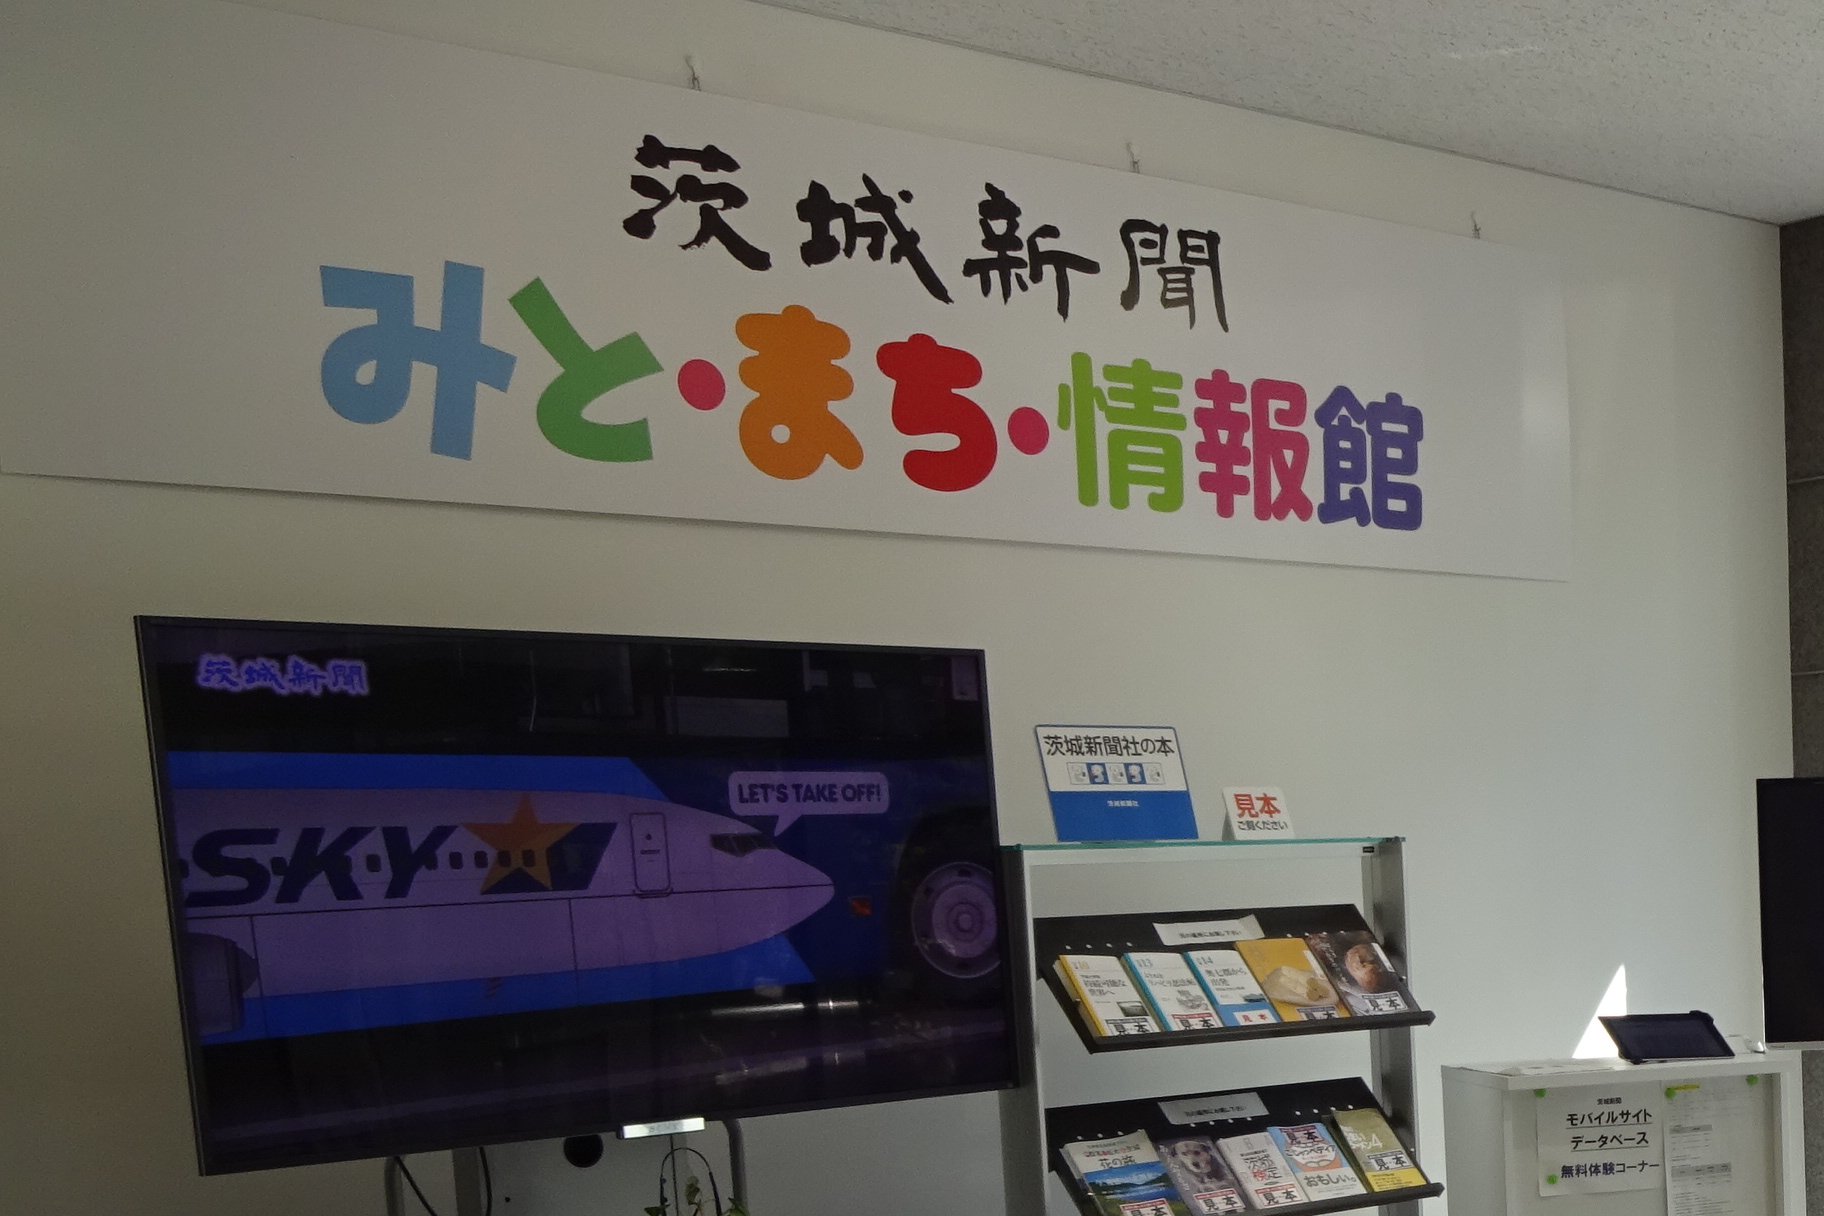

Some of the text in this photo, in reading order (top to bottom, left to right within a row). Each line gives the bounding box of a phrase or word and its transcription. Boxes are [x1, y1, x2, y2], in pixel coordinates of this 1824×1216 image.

[622, 134, 1229, 331] 茨城新聞
[198, 655, 368, 695] 茨城新聞
[1044, 735, 1175, 757] 茨城新聞社の本
[737, 782, 882, 806] LET'S TAKE OFF!
[1234, 793, 1282, 818] 見本
[1237, 820, 1288, 831] ご覧ください
[1370, 998, 1401, 1011] 見本
[1566, 1109, 1653, 1127] モバイルサイト
[1570, 1131, 1649, 1150] データベース
[1374, 1155, 1407, 1171] 見本
[1560, 1161, 1660, 1179] 無料体験コーナー
[1203, 1195, 1239, 1212] 見本
[1262, 1189, 1298, 1204] 見本
